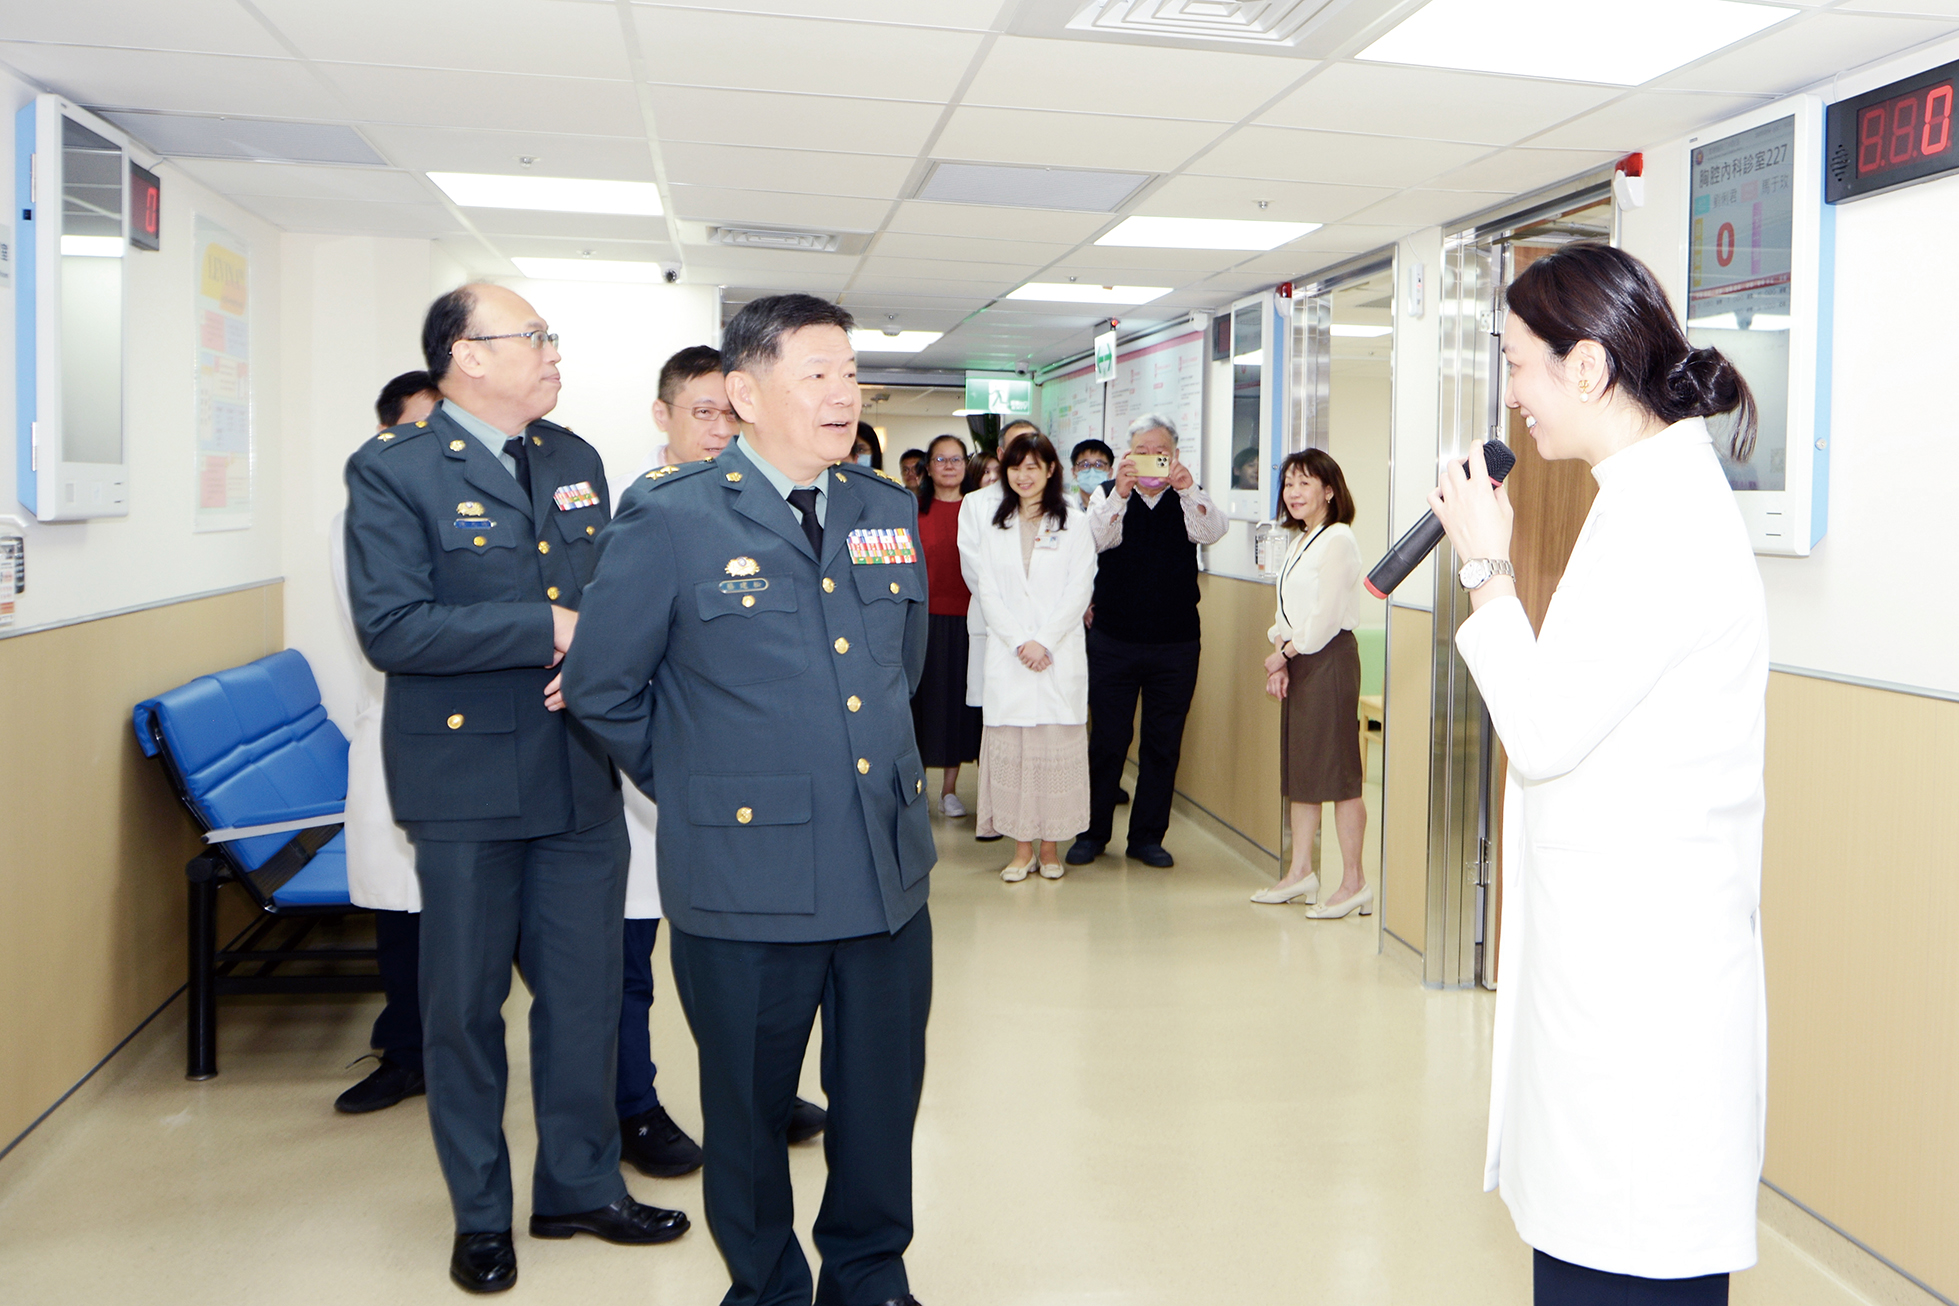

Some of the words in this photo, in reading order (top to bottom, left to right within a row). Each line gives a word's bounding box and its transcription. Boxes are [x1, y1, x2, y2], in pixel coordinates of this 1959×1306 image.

[1699, 143, 1788, 189] 胸腔內科診室227
[146, 187, 157, 234] 0
[1716, 222, 1735, 267] 0
